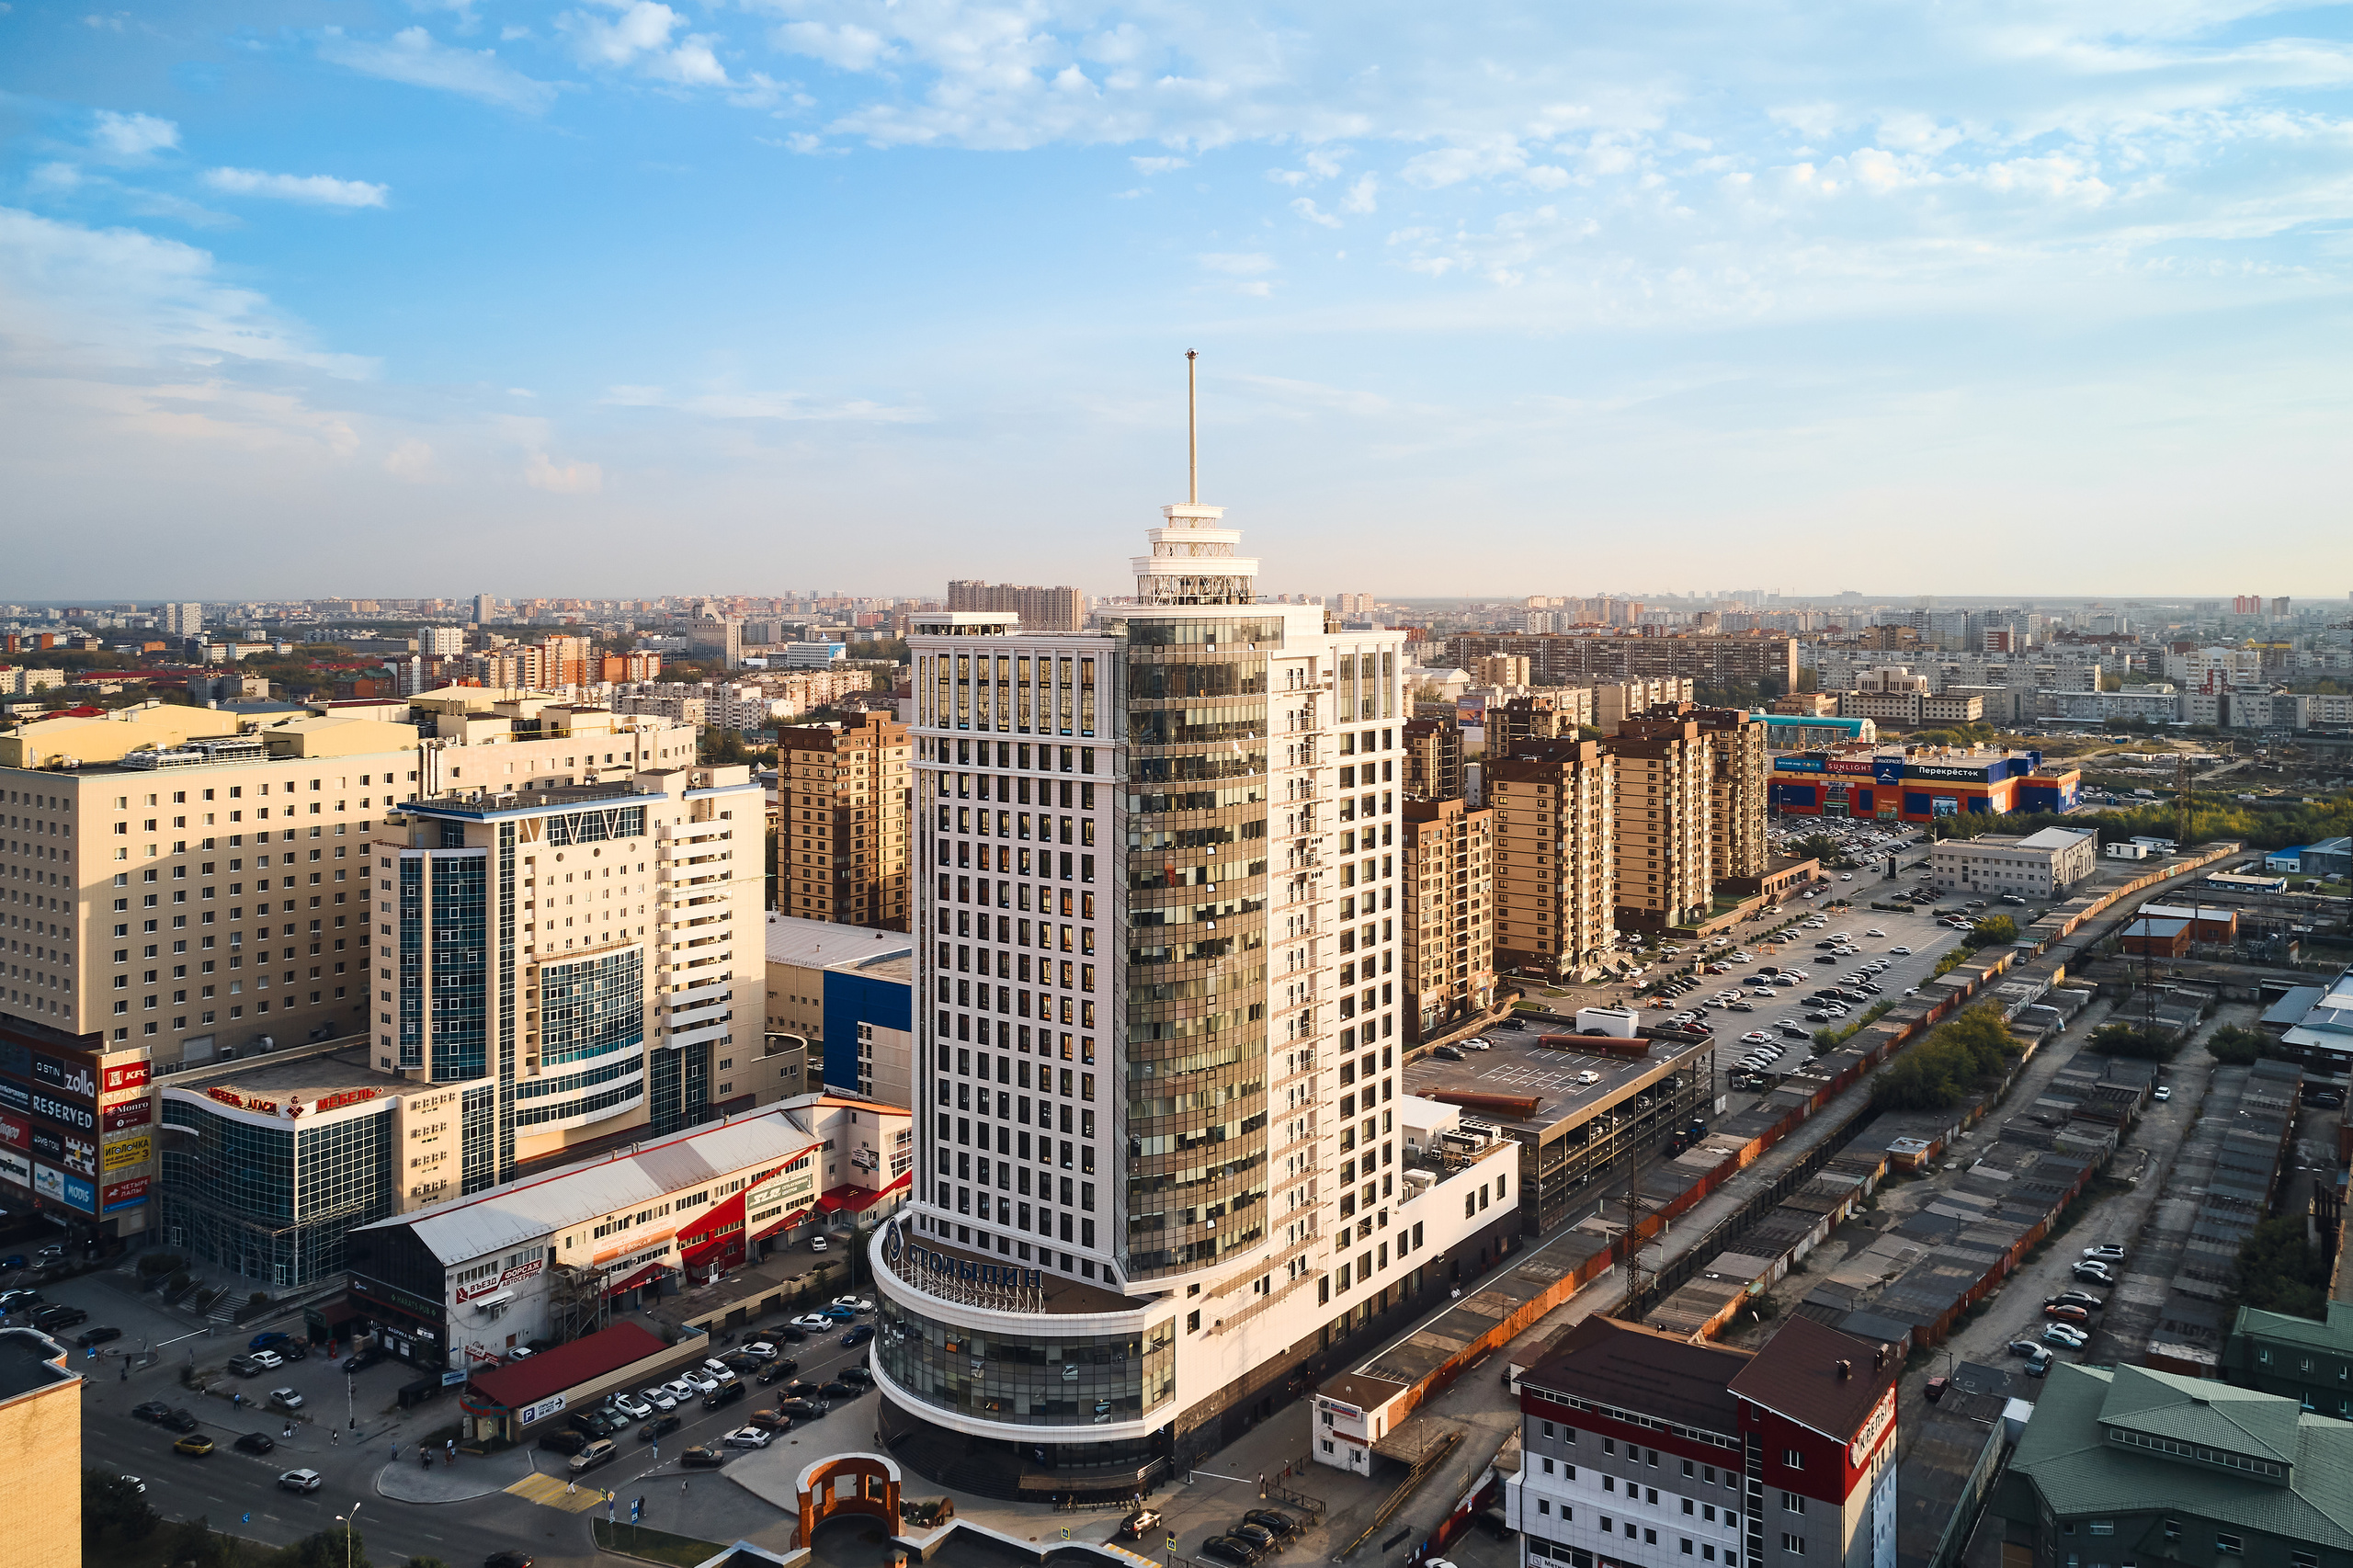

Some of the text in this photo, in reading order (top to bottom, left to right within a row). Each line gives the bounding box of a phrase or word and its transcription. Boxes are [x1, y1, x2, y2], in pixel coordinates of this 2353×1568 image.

[1828, 763, 1872, 771] SUNLIGHT
[125, 1068, 149, 1081] KFC
[65, 1069, 95, 1098] zolla
[317, 1087, 376, 1110] МЕБЕЛЬ
[33, 1095, 93, 1129] RESERVED
[117, 1101, 149, 1113] Monro
[142, 1149, 149, 1158] 3
[120, 1178, 149, 1190] ЧЕТЫРЕ
[68, 1184, 89, 1203] MODIS
[120, 1187, 142, 1198] ЛАПЫ
[505, 1260, 540, 1279] ФОРСАЖ
[909, 1243, 1044, 1289] СТОЛЫПИН
[470, 1277, 497, 1292] ВЪЕЗД
[502, 1268, 540, 1288] АВТОСЕРВИС
[526, 1410, 533, 1421] P
